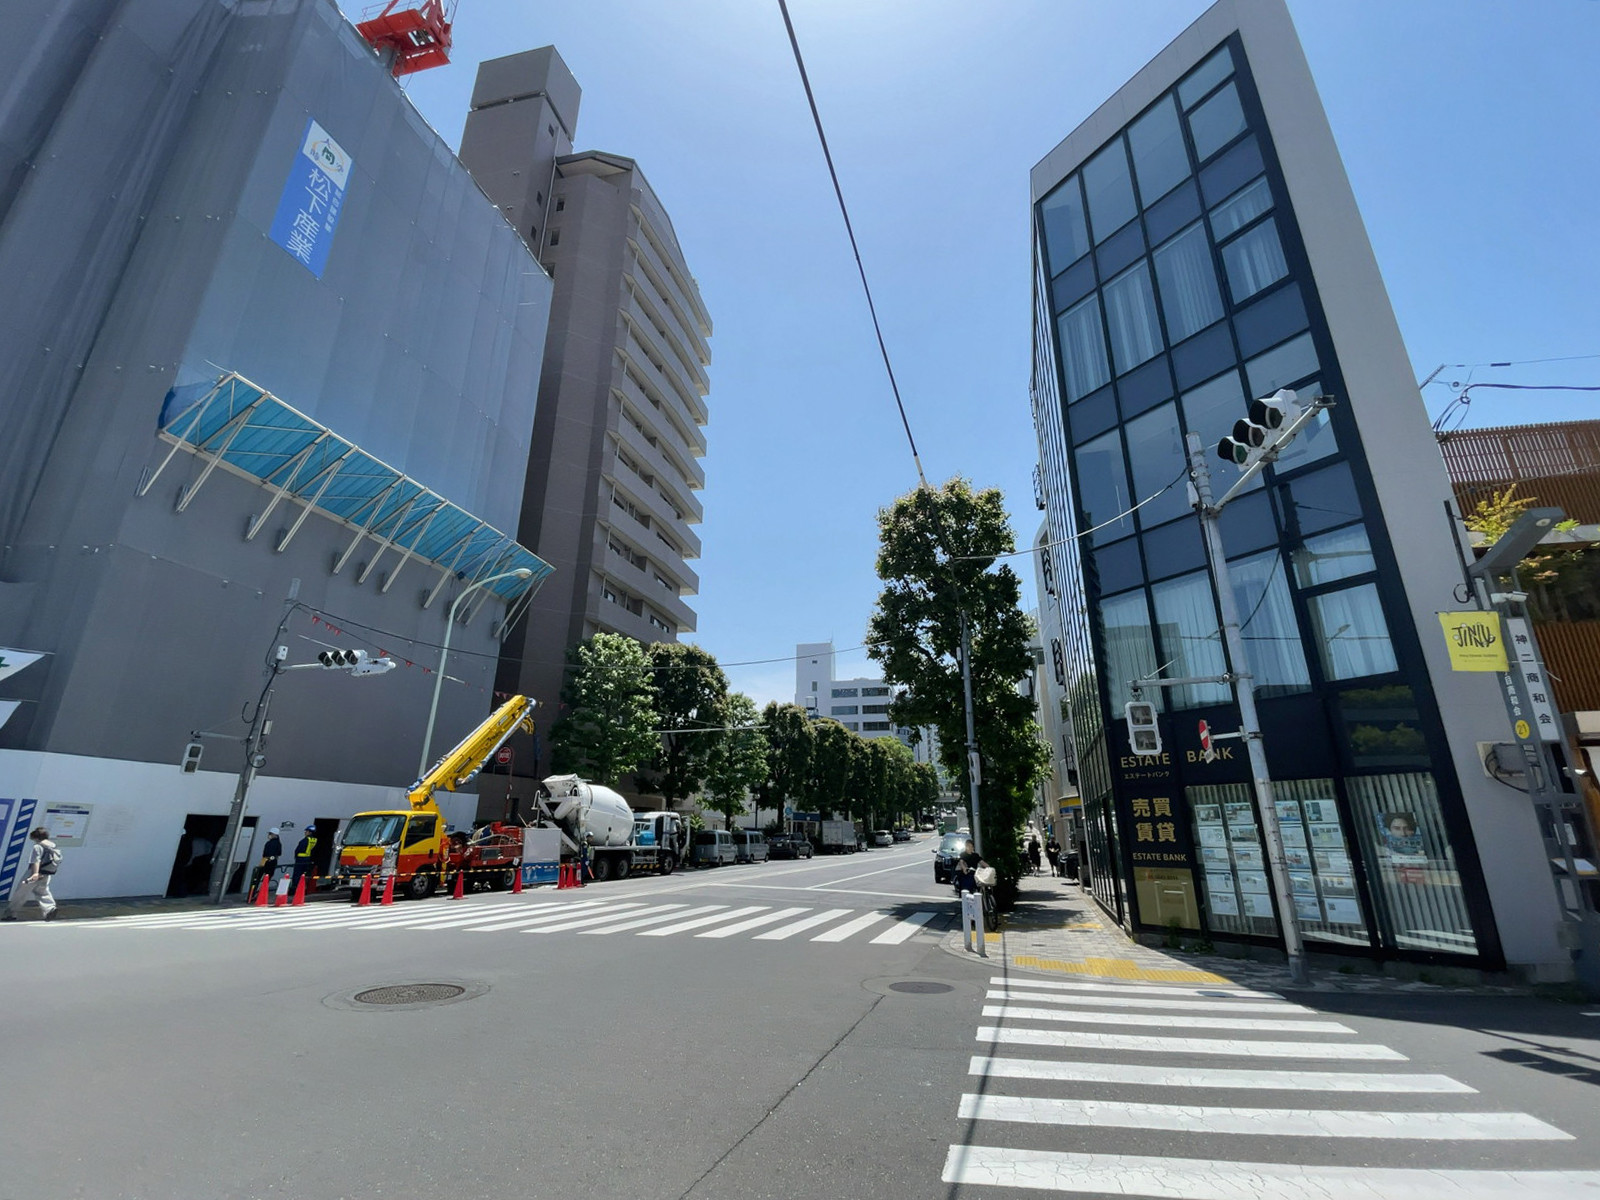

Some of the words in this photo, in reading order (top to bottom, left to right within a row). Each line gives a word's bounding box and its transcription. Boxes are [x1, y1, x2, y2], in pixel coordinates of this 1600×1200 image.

[286, 168, 331, 264] 松下産業
[1515, 634, 1551, 724] 神二商和会
[1121, 753, 1171, 768] ESTATE
[1124, 771, 1170, 780] エステートバンク
[1132, 798, 1172, 817] 売買
[1136, 822, 1176, 842] 賃貸
[1132, 853, 1161, 861] ESTATE
[1162, 853, 1187, 862] BANK
